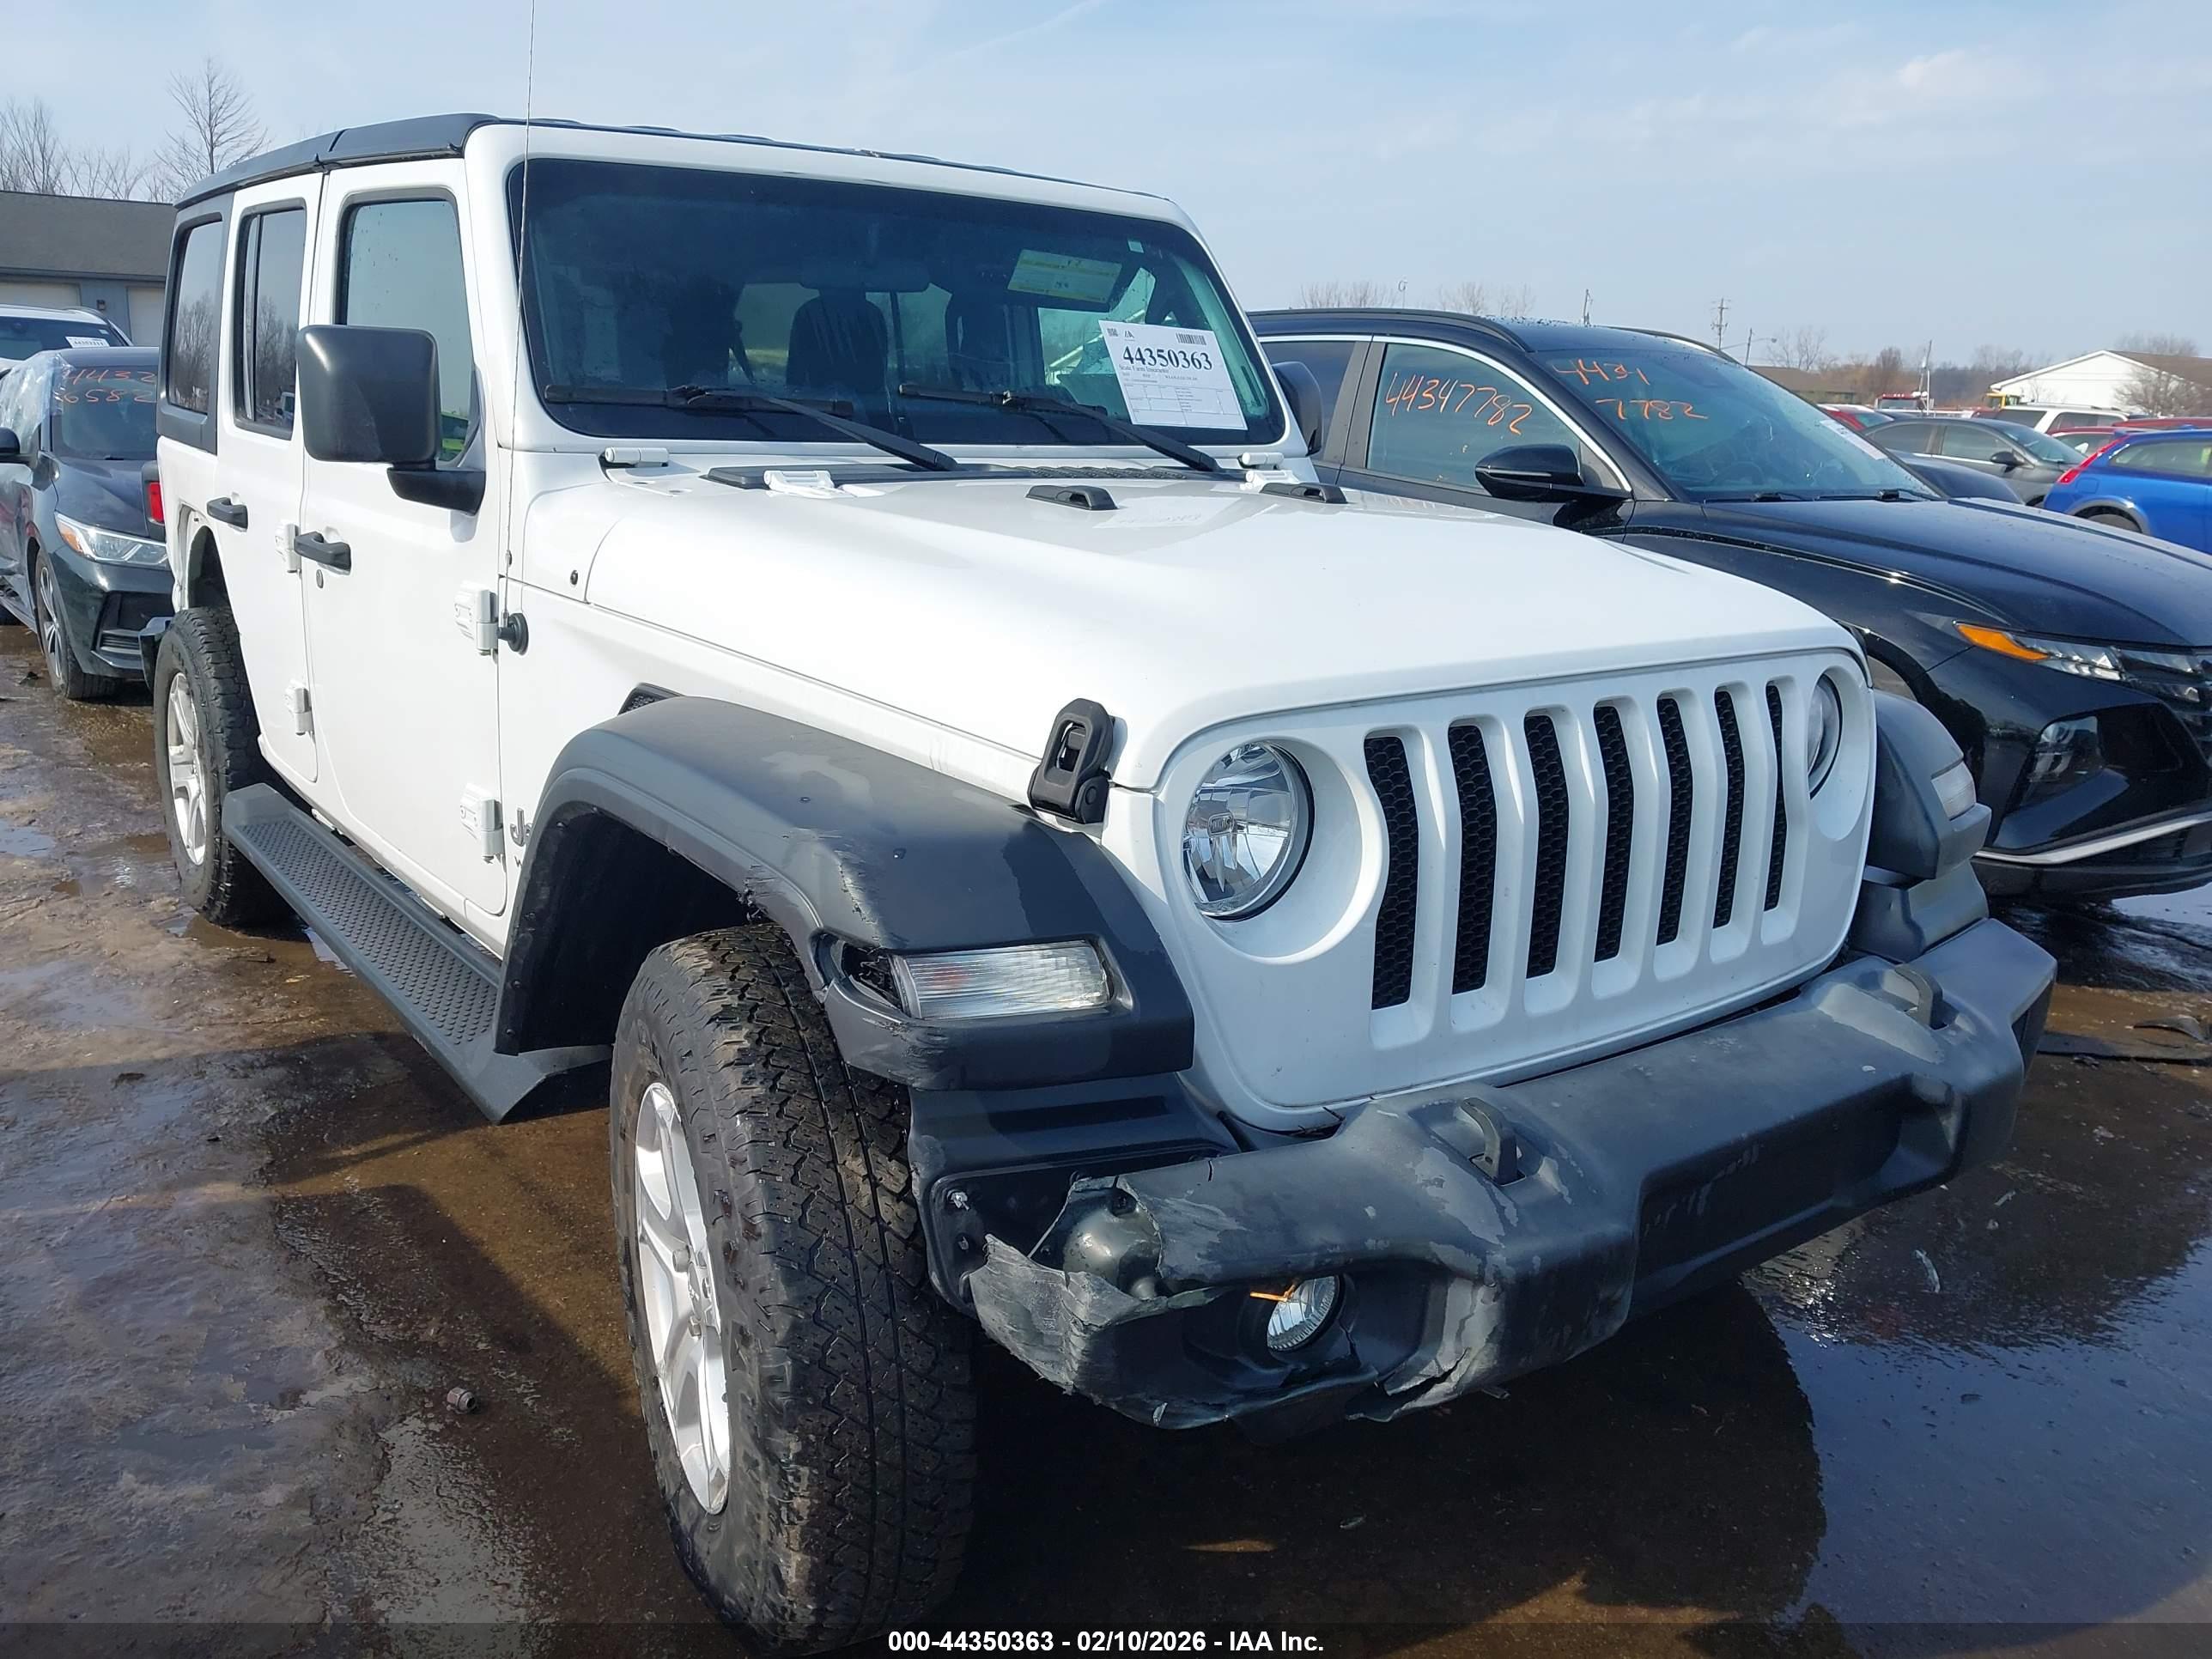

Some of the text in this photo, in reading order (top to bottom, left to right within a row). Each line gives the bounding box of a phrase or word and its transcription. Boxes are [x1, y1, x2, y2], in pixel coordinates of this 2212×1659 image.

[1123, 346, 1212, 370] 44350363
[64, 389, 157, 404] 6582
[1385, 372, 1532, 435] 44347782
[1595, 398, 1708, 420] 7782
